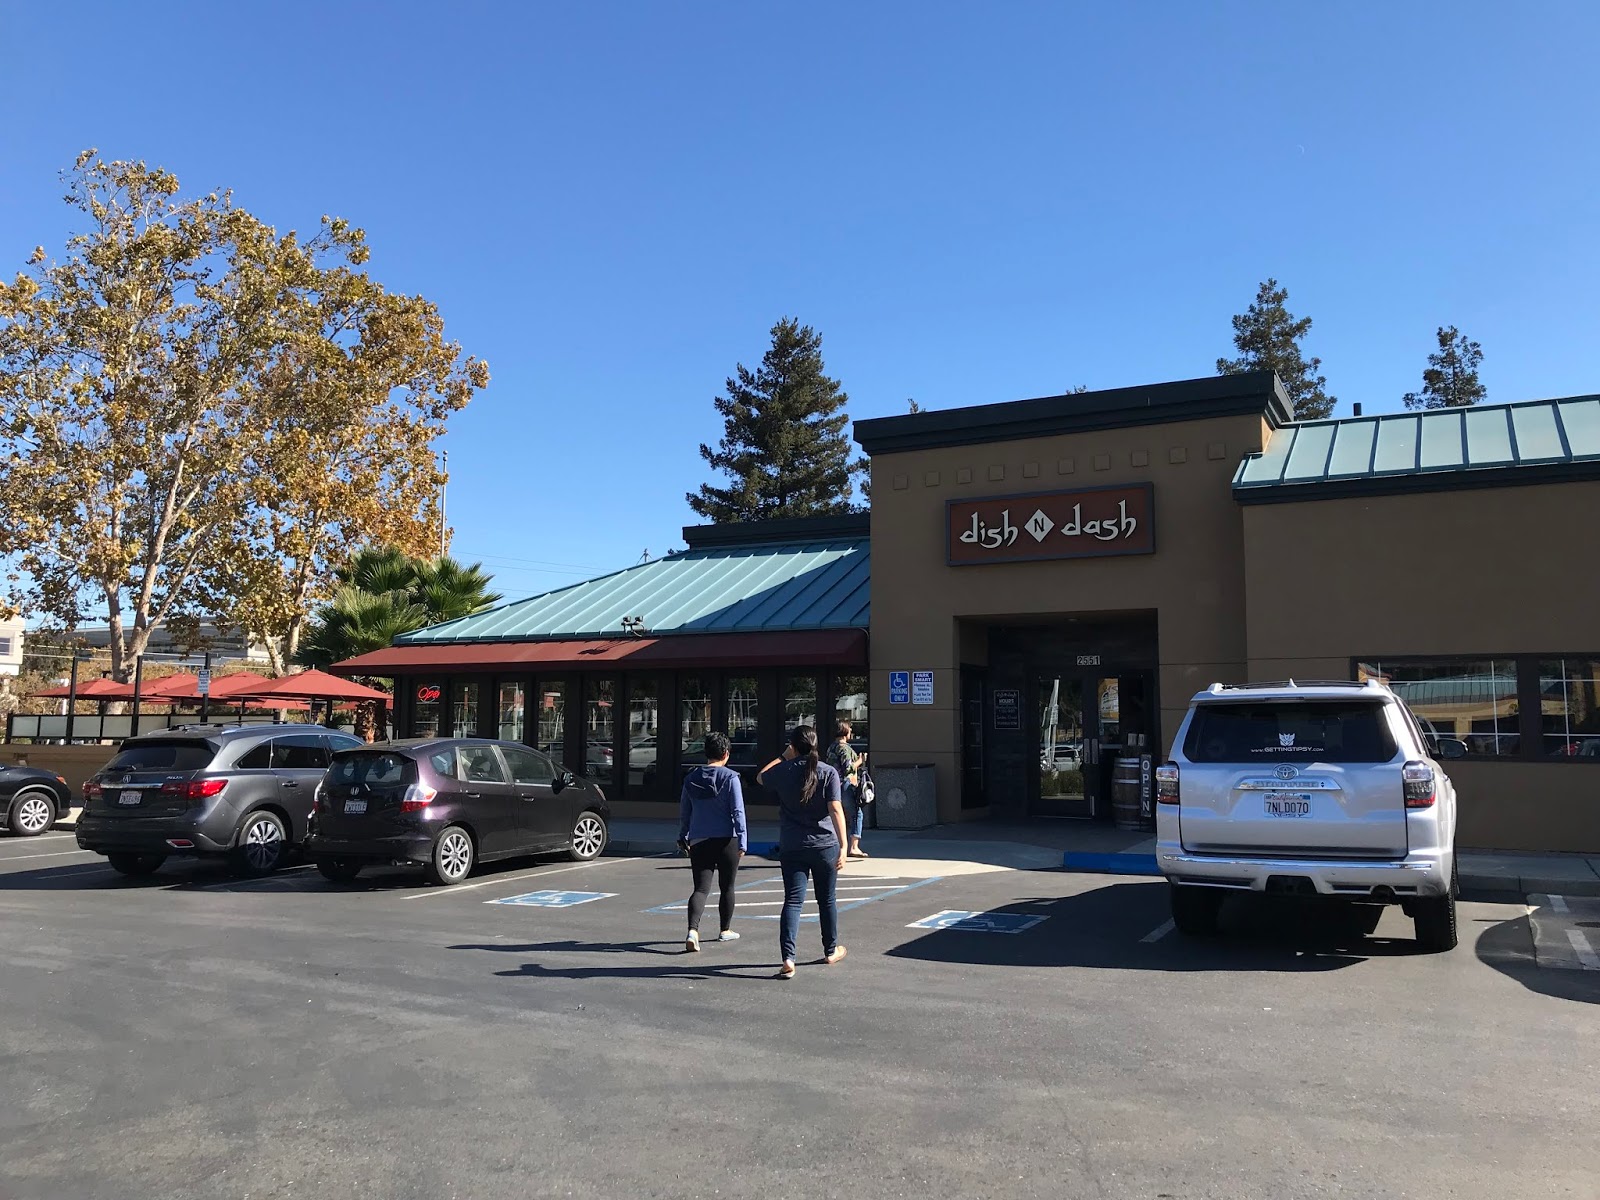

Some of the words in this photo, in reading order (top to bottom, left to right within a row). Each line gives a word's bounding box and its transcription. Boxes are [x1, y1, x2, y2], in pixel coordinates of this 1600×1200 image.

[959, 509, 1019, 549] dish
[1060, 499, 1137, 541] dash
[1077, 656, 1100, 665] 2551
[1142, 760, 1150, 811] OPEN
[1266, 802, 1309, 813] 7NLD070
